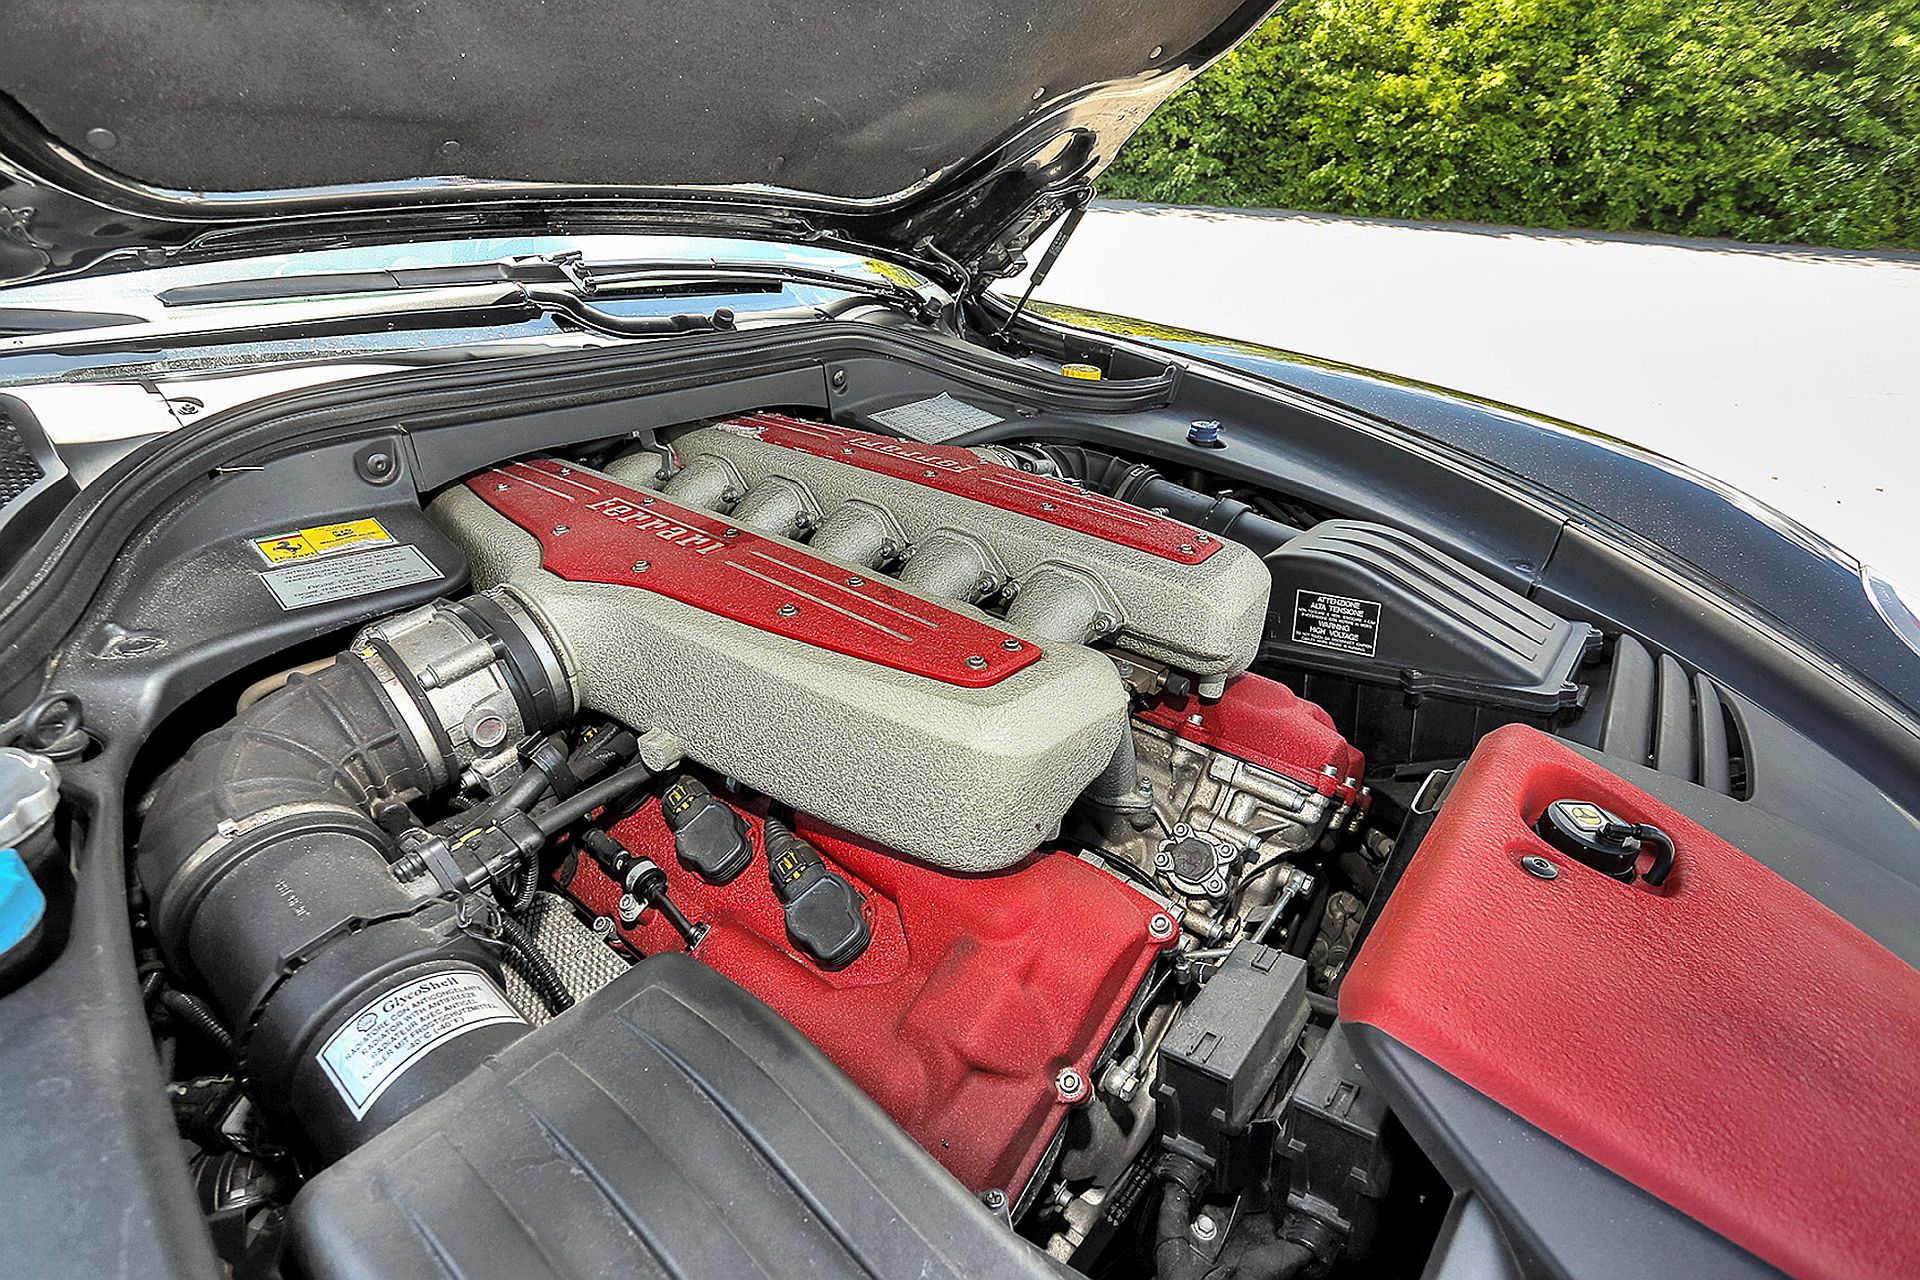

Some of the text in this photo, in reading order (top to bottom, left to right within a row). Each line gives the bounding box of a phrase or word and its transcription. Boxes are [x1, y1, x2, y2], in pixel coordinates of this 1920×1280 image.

[585, 496, 727, 555] Ferrari
[1309, 625, 1359, 641] HIGH VOLTAGE
[345, 984, 484, 1061] RADIATORE CON ANTICONGELANTE
[361, 992, 478, 1057] RADIATOR WITH ANTIFREEZE
[383, 977, 459, 1014] GlycoShell
[371, 999, 480, 1059] RADIATEUR AVEC ANTIGEL
[394, 1035, 410, 1052] MIT
[410, 1002, 499, 1040] FROSTSCHUTZMITTEL
